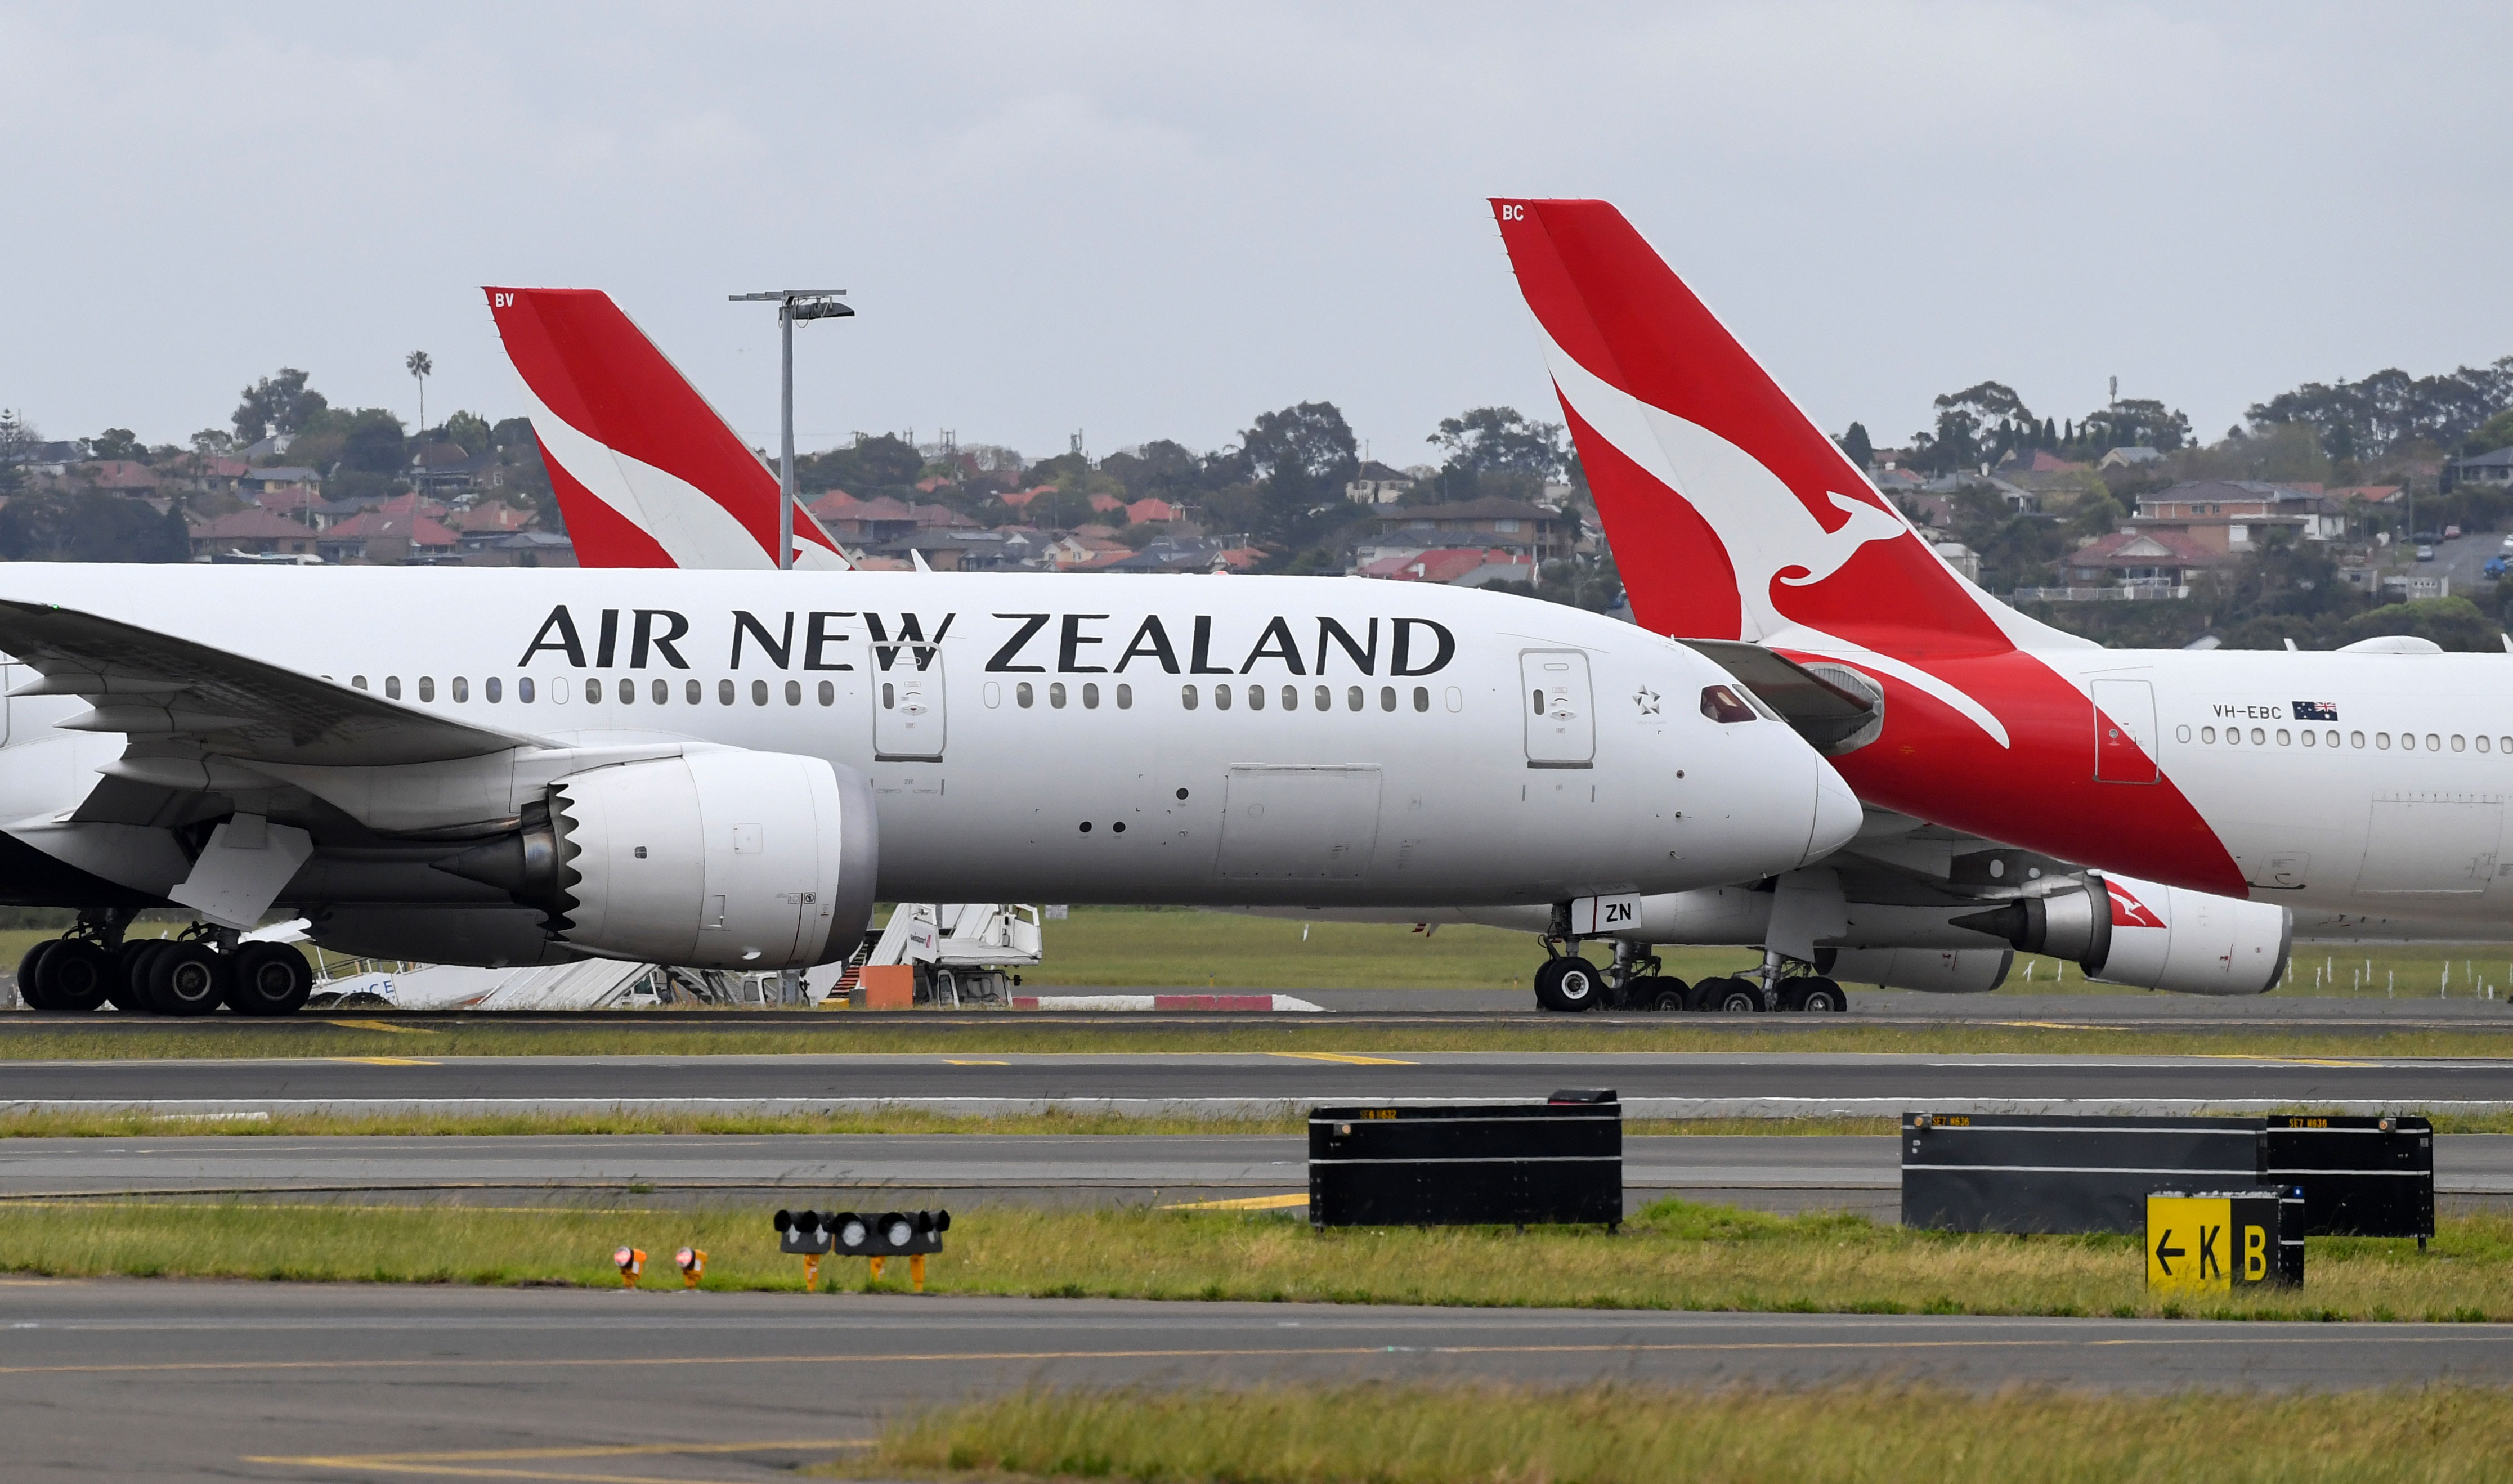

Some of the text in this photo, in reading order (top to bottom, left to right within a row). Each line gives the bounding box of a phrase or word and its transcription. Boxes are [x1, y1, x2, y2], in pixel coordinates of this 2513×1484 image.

[1503, 204, 1524, 221] BC
[495, 293, 514, 307] BV
[517, 605, 1455, 676] AIR NEW ZEALAND
[2213, 704, 2282, 719] VH-EBC
[1606, 903, 1631, 922] ZN
[2200, 1225, 2220, 1280] K
[2245, 1225, 2266, 1280] B
